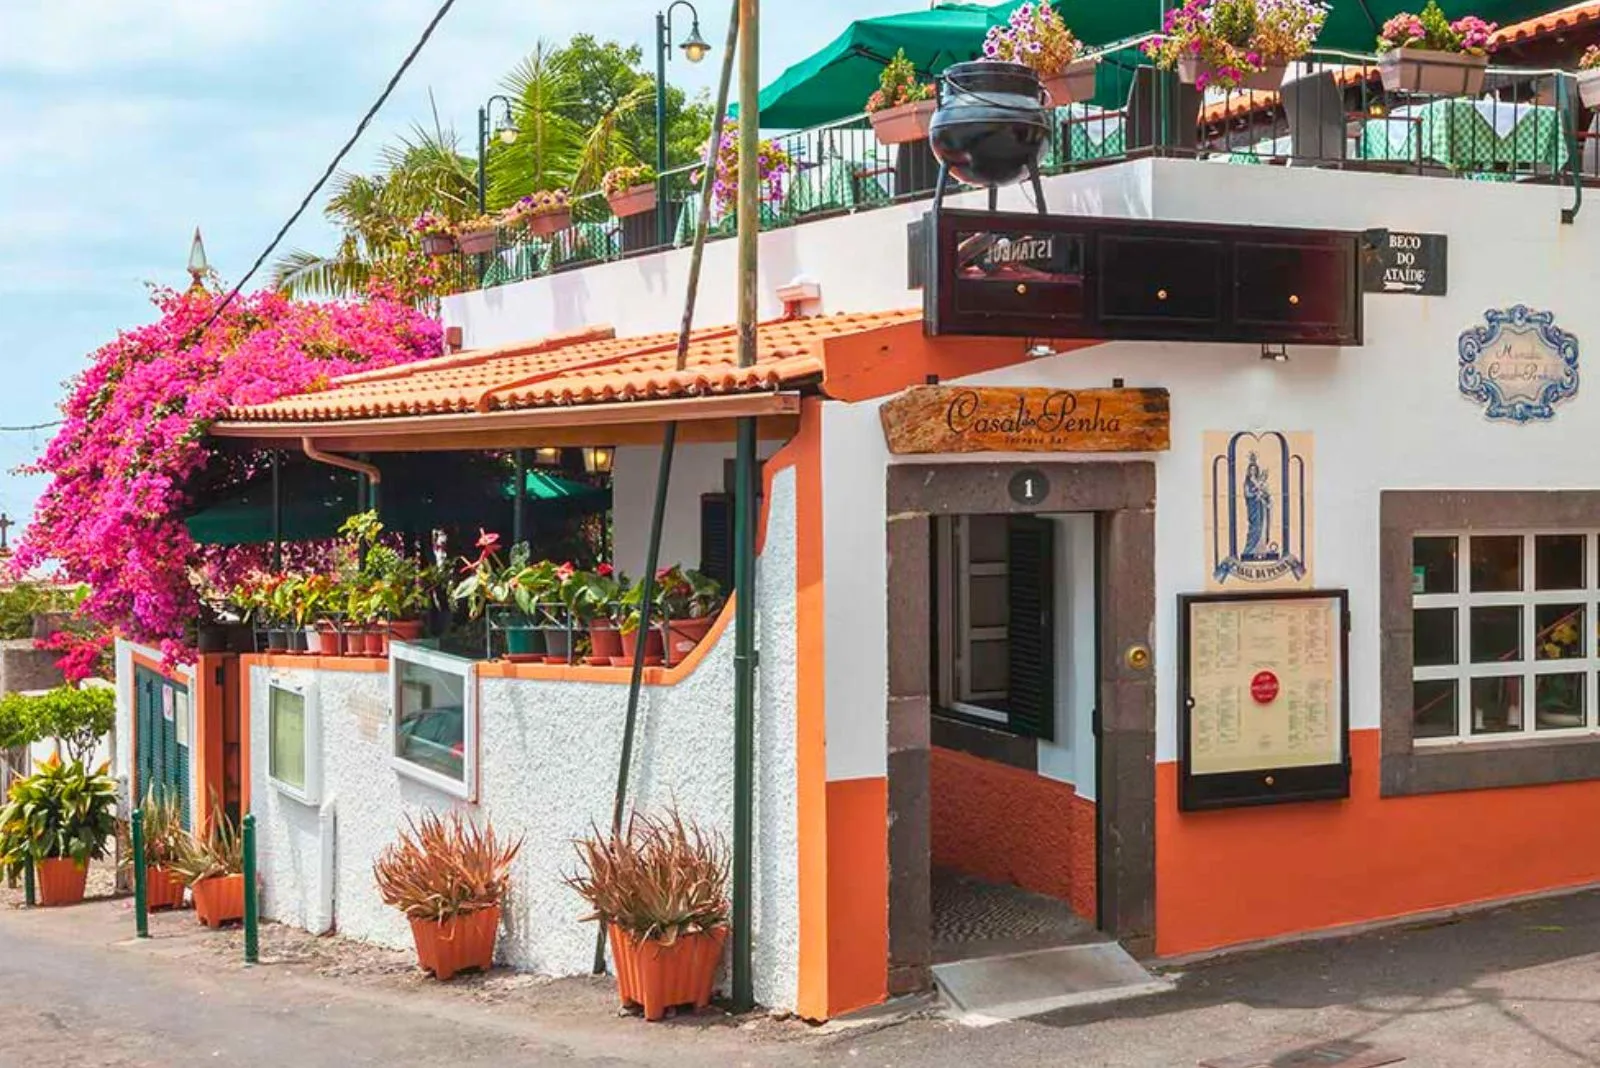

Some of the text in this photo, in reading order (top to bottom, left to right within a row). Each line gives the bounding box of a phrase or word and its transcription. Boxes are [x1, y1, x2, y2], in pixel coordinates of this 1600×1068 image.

[1389, 234, 1421, 249] BECO
[1397, 252, 1415, 265] DO
[1383, 265, 1426, 283] ATAÍDE
[947, 390, 1025, 434] Casal
[1036, 390, 1121, 433] Penha
[1024, 479, 1034, 498] 1
